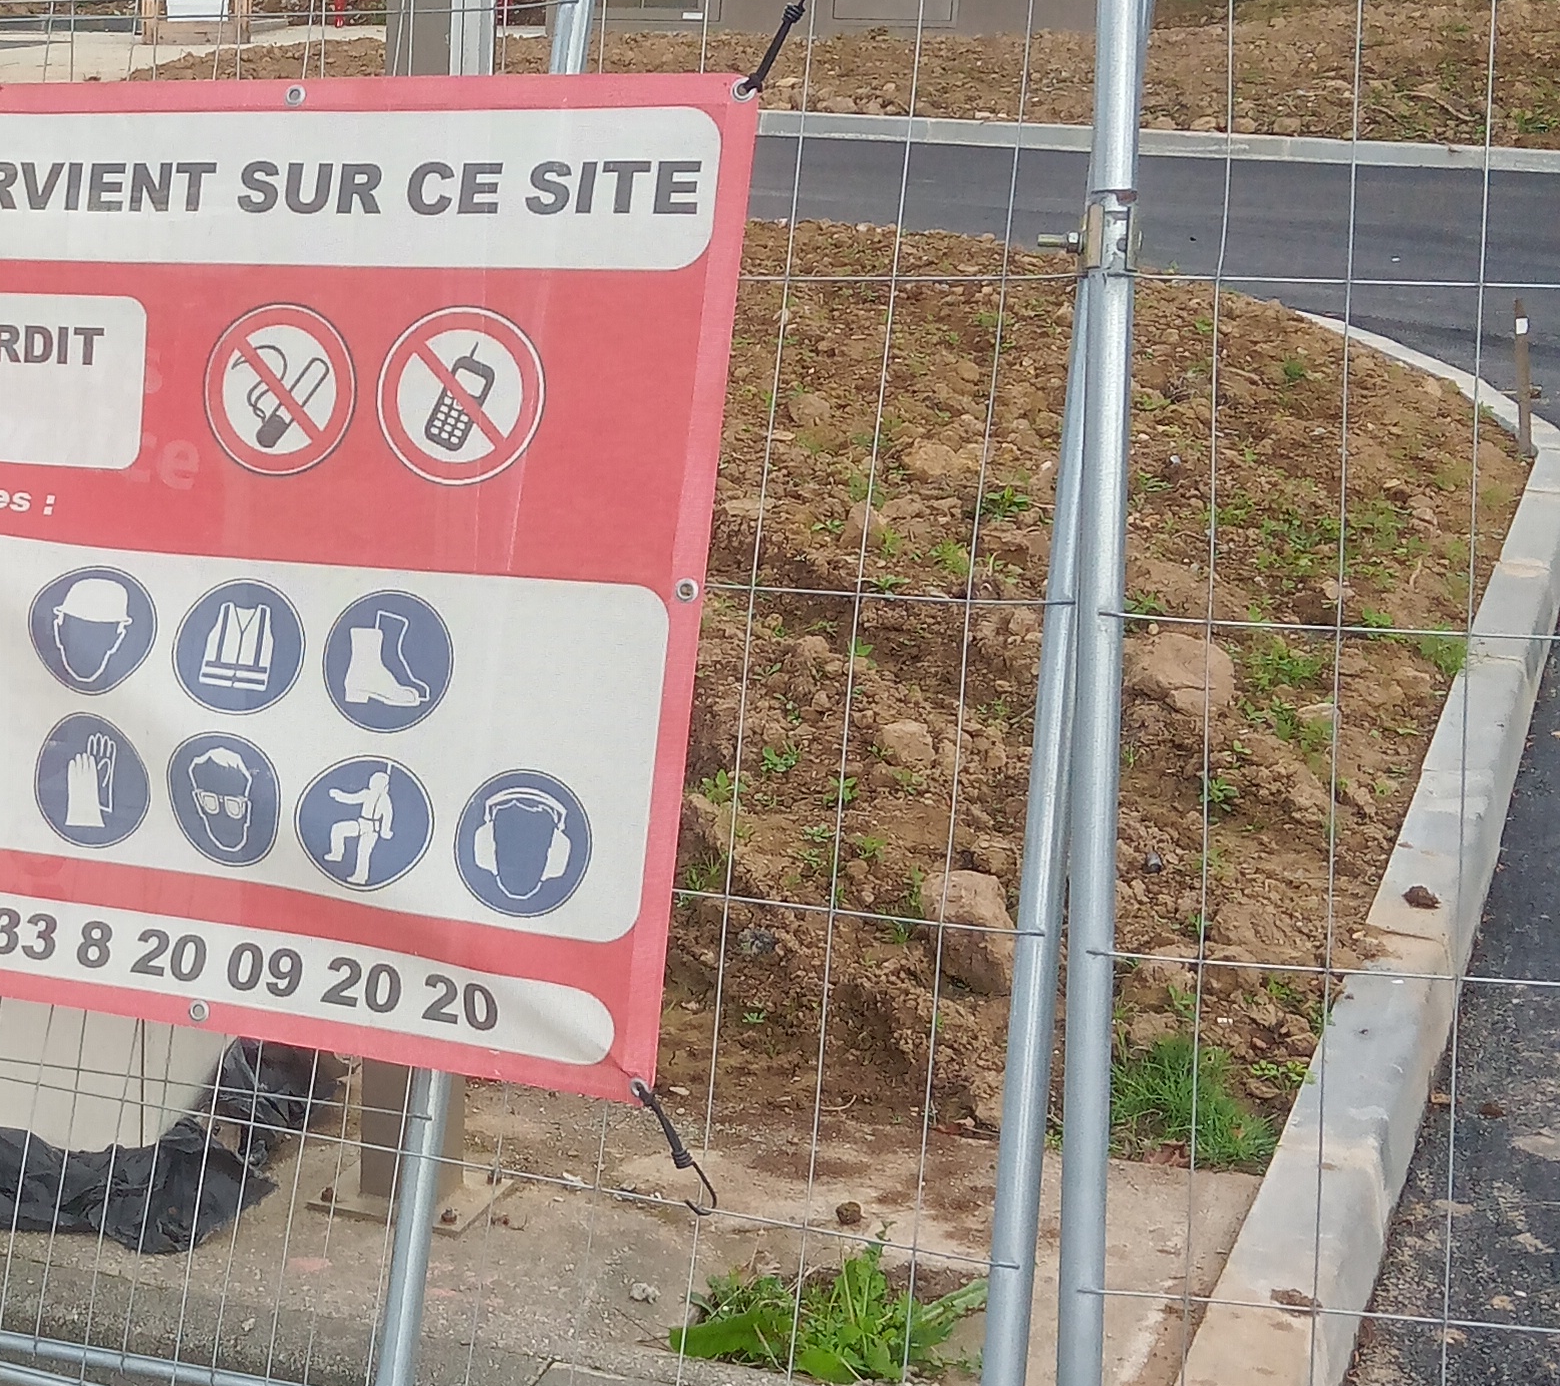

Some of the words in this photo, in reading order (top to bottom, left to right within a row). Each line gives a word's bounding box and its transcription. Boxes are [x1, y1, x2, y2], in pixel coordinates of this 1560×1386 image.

[237, 160, 383, 215] SUR
[406, 161, 504, 215] CE
[525, 159, 702, 215] SITE
[75, 919, 114, 969] 8
[130, 928, 208, 983] 20
[226, 941, 303, 997] 09
[320, 956, 403, 1014] 20
[421, 972, 499, 1032] 20
